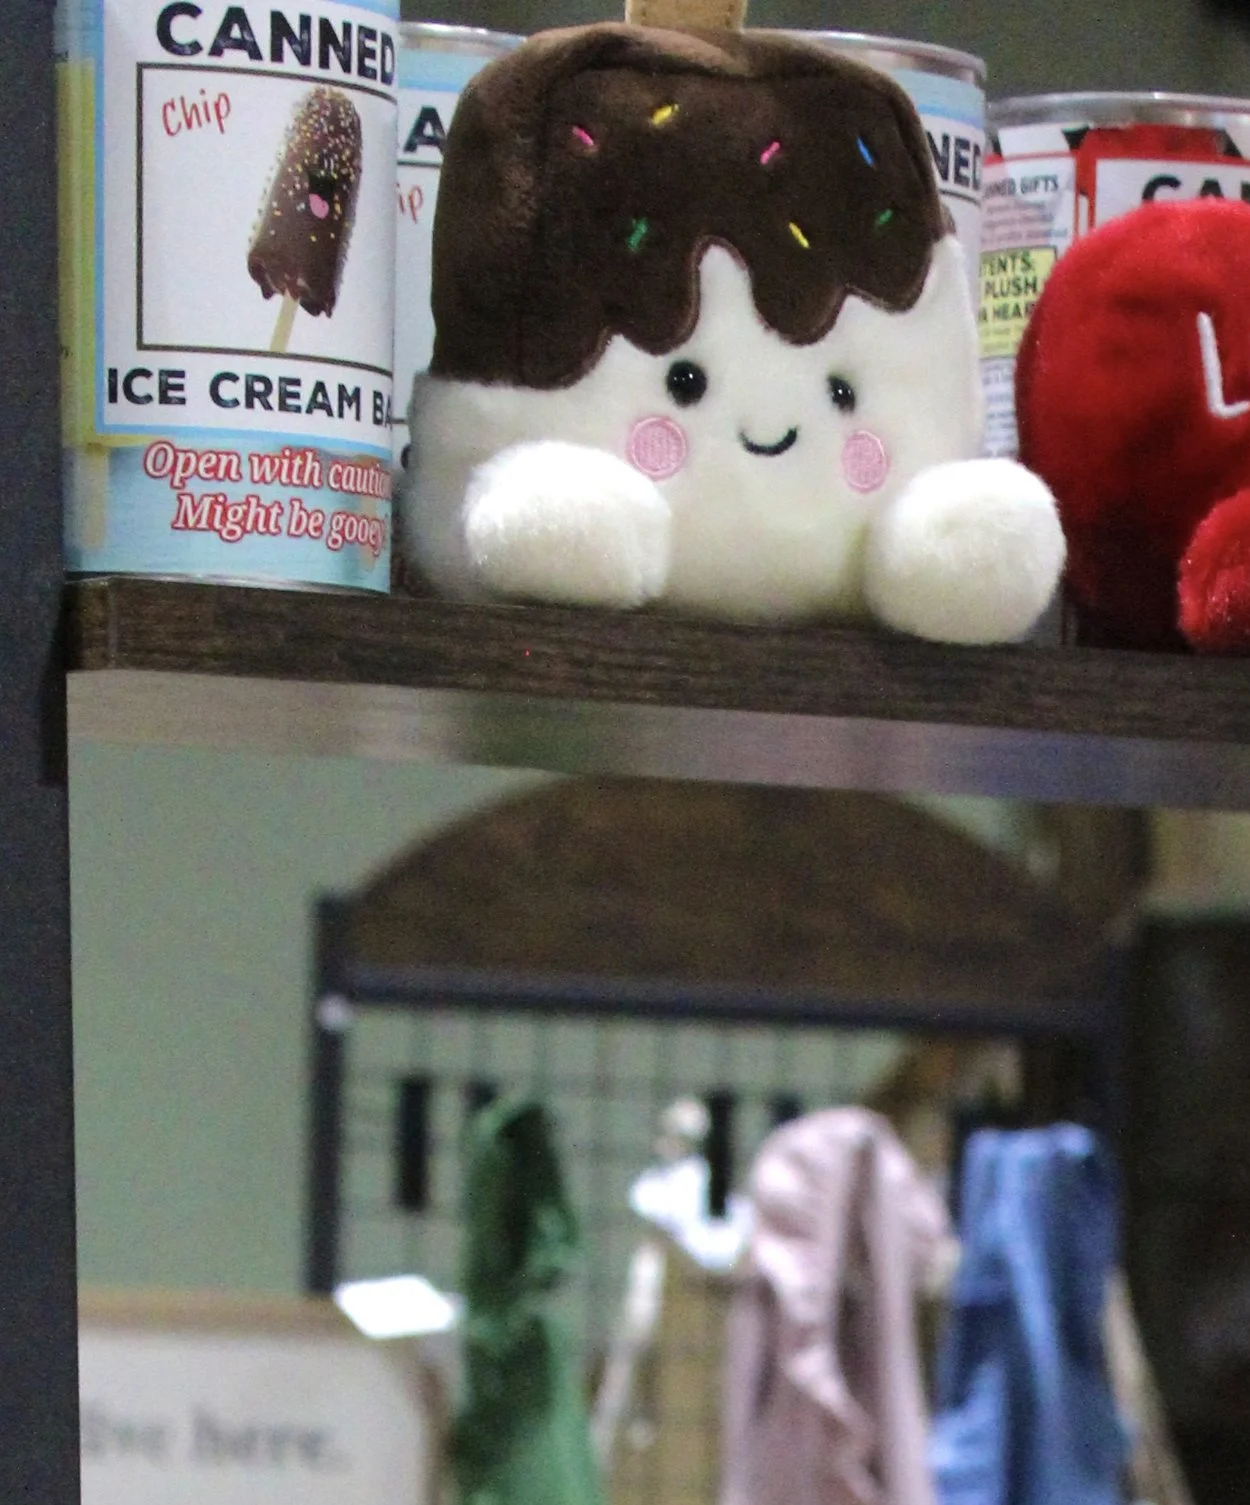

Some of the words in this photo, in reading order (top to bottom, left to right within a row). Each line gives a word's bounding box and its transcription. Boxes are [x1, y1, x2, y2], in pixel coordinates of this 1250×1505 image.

[156, 2, 396, 86] CANNED
[162, 89, 231, 137] Chip
[106, 368, 187, 405] ICE
[209, 371, 362, 422] CREAM
[144, 440, 242, 489] Open
[249, 445, 323, 489] with
[172, 492, 282, 542] Might
[288, 497, 325, 538] be
